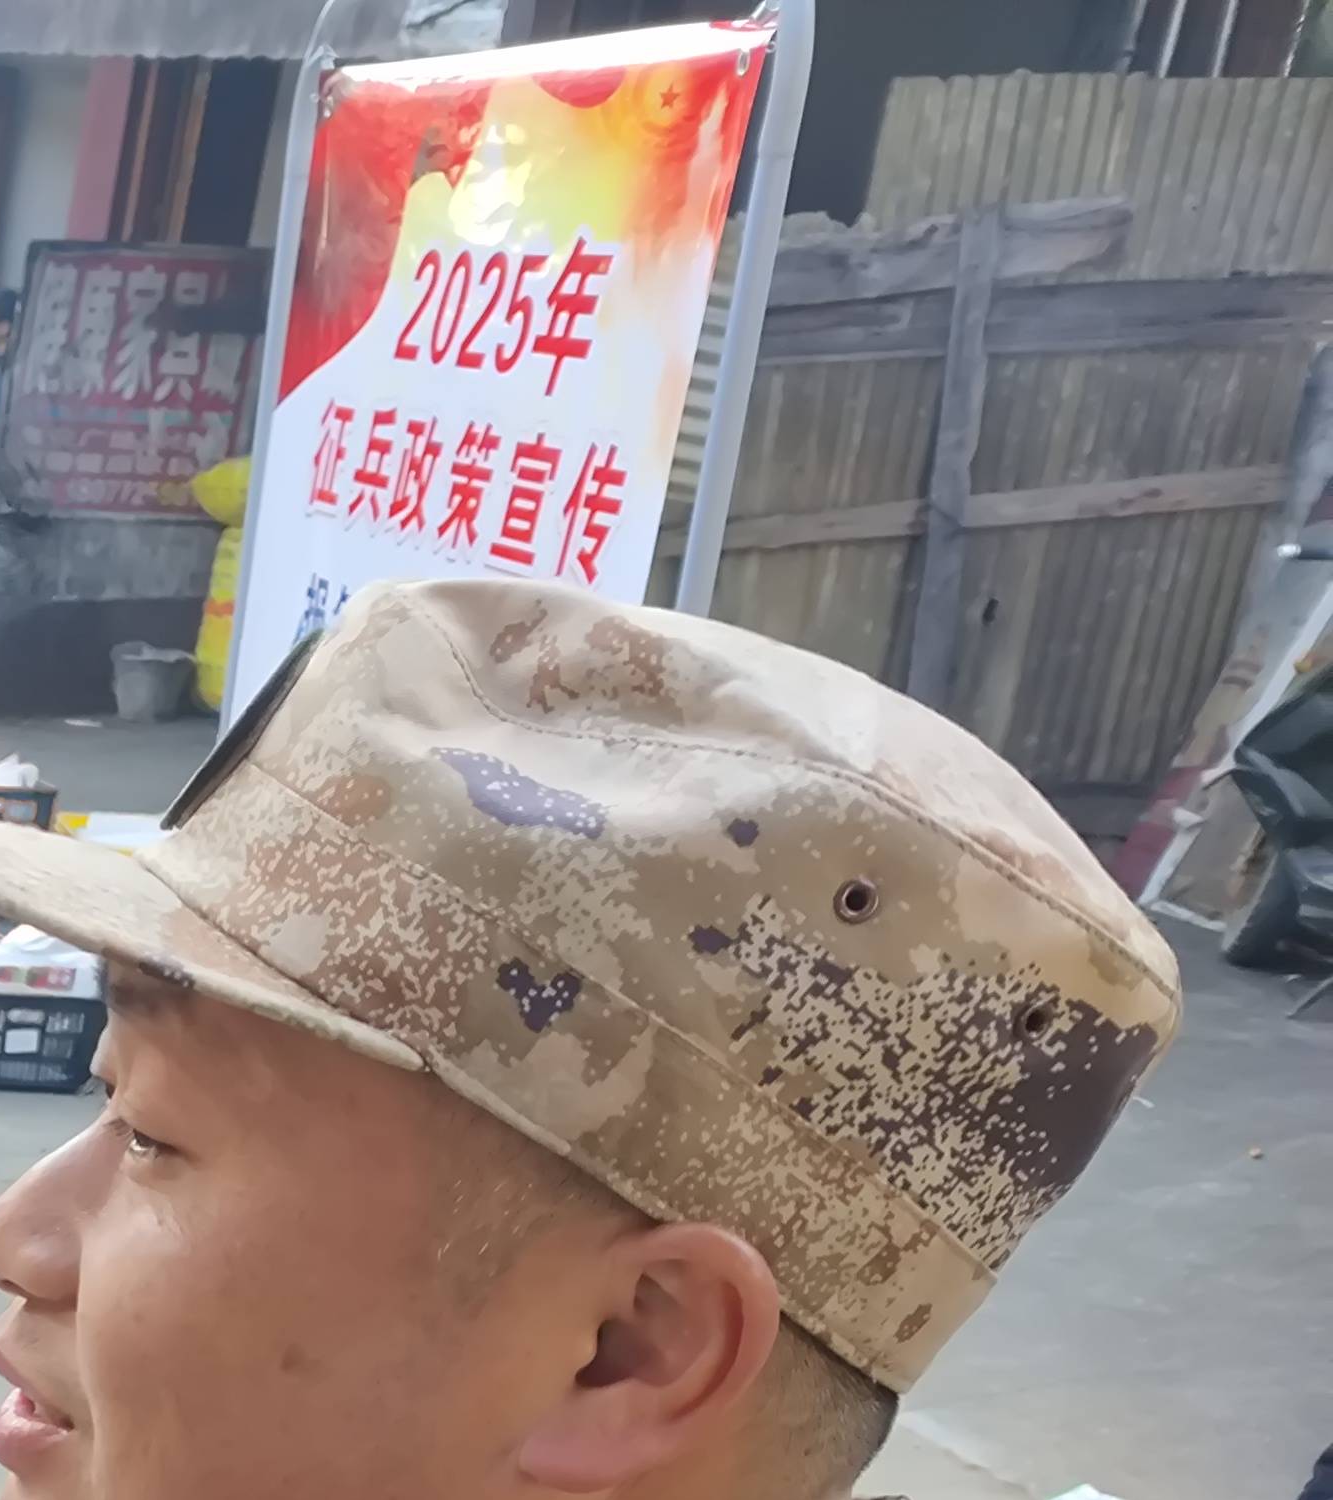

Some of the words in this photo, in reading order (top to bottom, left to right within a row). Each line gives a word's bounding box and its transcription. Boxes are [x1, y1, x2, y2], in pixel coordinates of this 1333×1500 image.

[393, 236, 614, 397] 2025年
[309, 400, 628, 585] 征兵政策宣传
